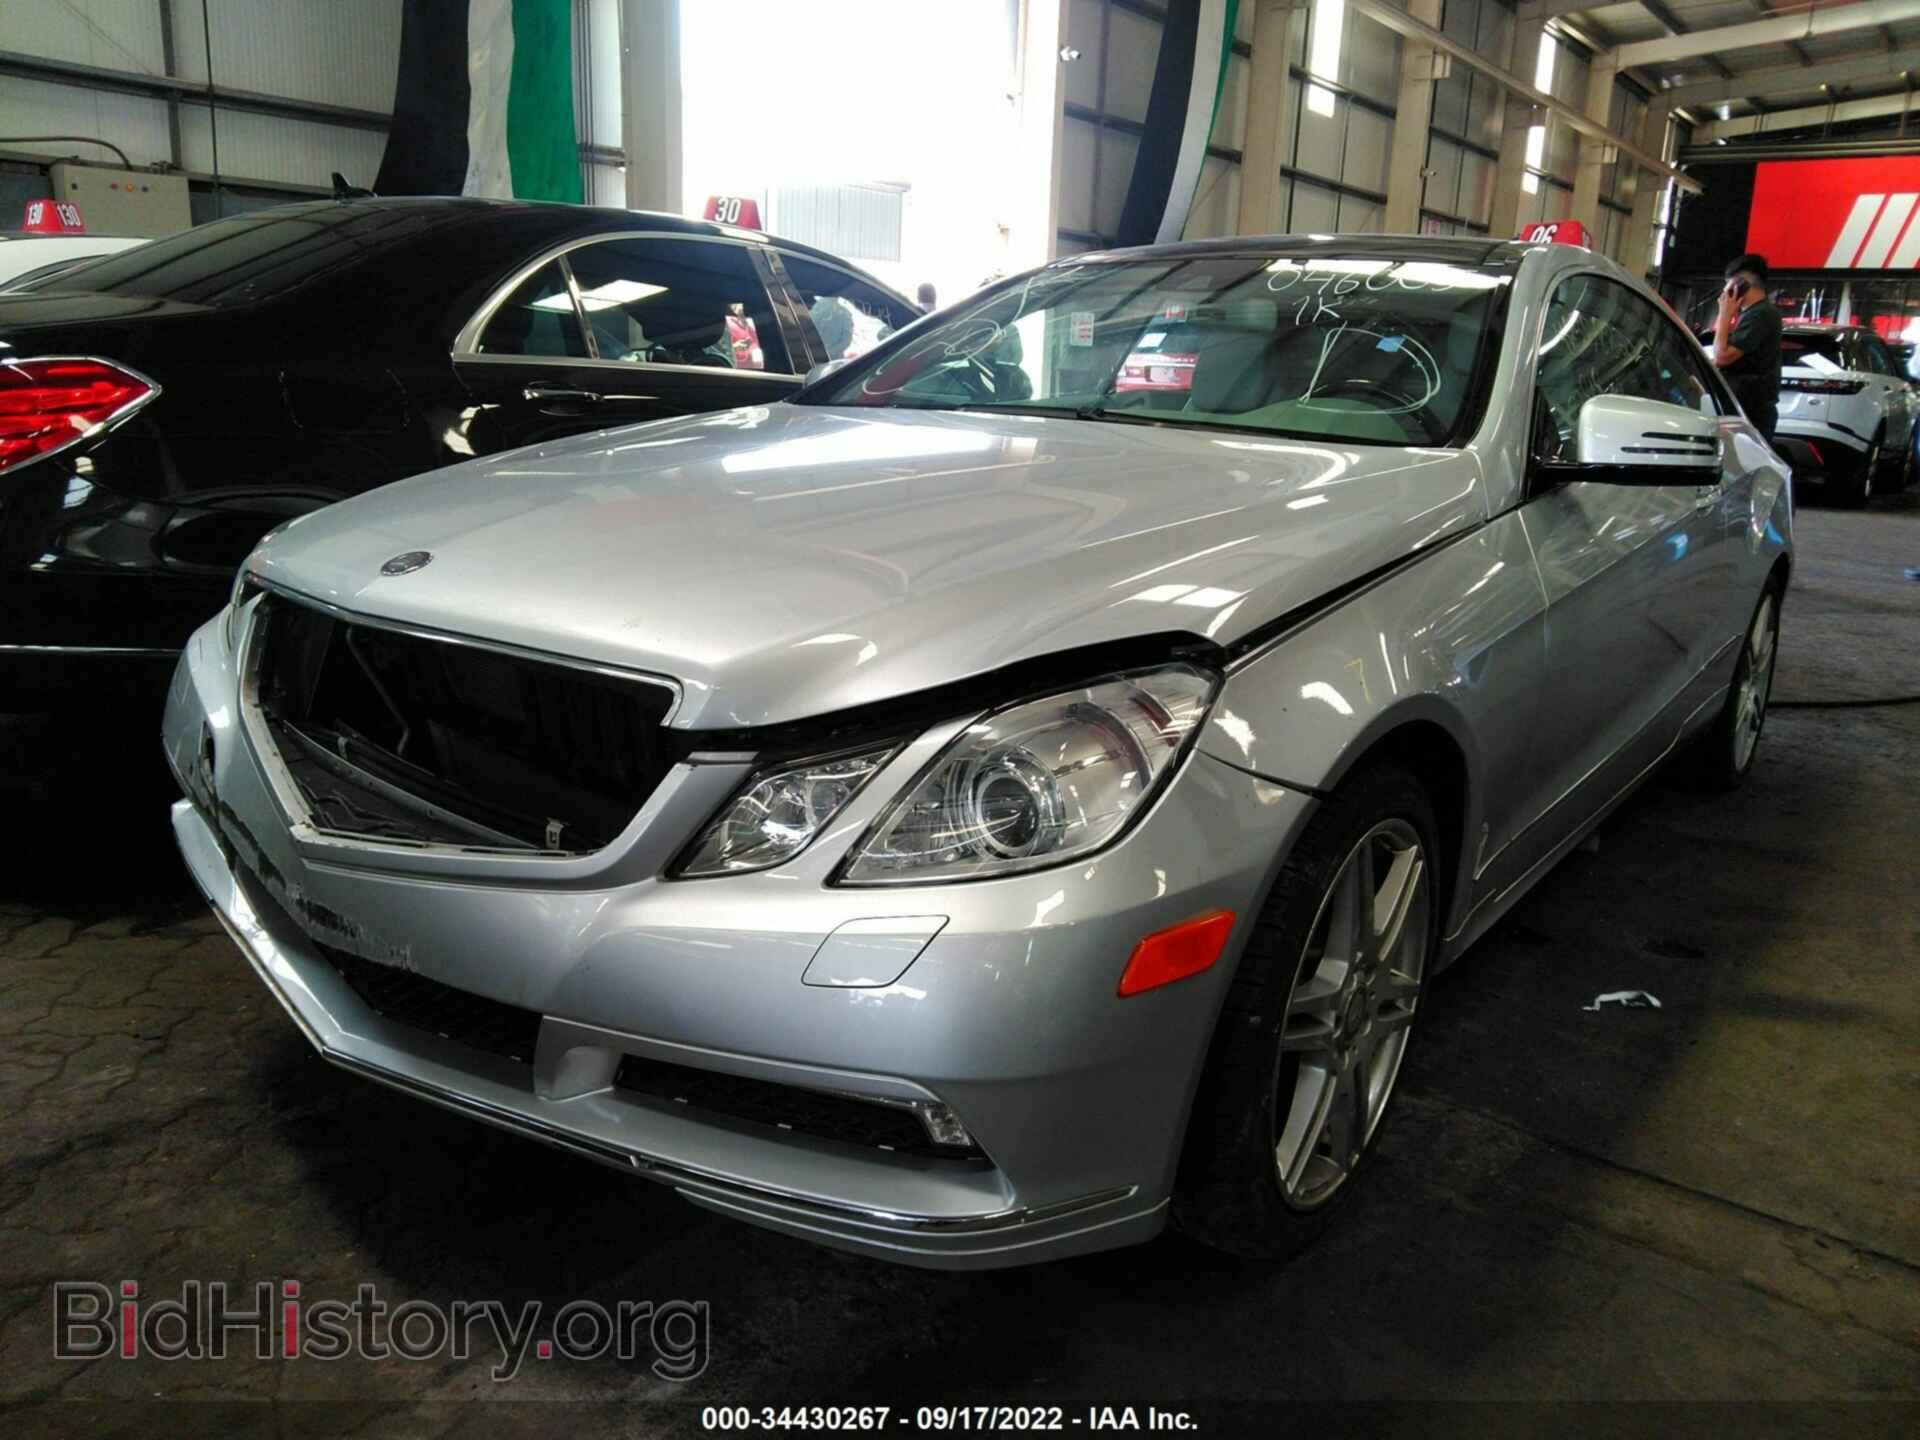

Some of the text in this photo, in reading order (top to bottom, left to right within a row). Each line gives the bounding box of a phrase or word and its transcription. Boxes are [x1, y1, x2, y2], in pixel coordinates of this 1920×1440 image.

[27, 202, 44, 225] 130
[56, 203, 81, 227] 130
[715, 198, 741, 223] 30
